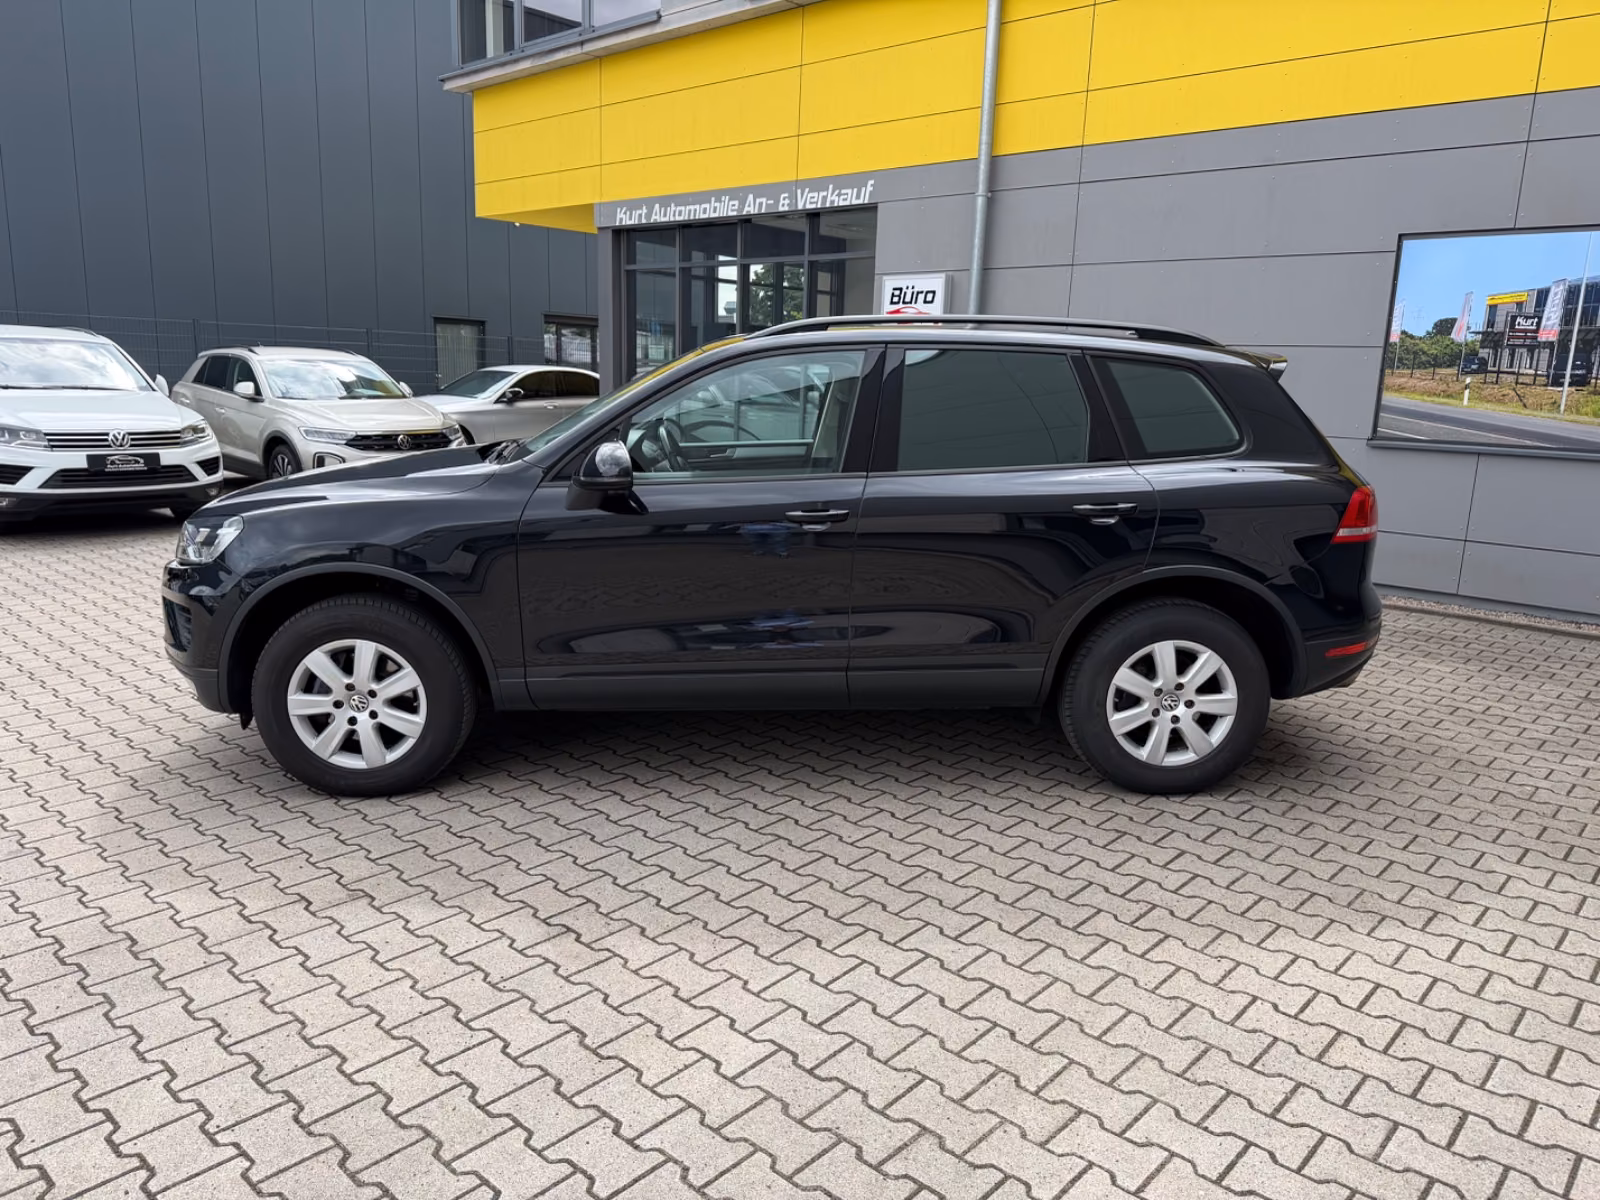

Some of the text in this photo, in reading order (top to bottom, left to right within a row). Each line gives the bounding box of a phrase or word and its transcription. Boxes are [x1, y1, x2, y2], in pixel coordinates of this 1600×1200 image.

[615, 179, 875, 226] Kurt Automobile An- & Verkauf
[889, 285, 936, 305] Büro
[1515, 315, 1538, 326] Kurt
